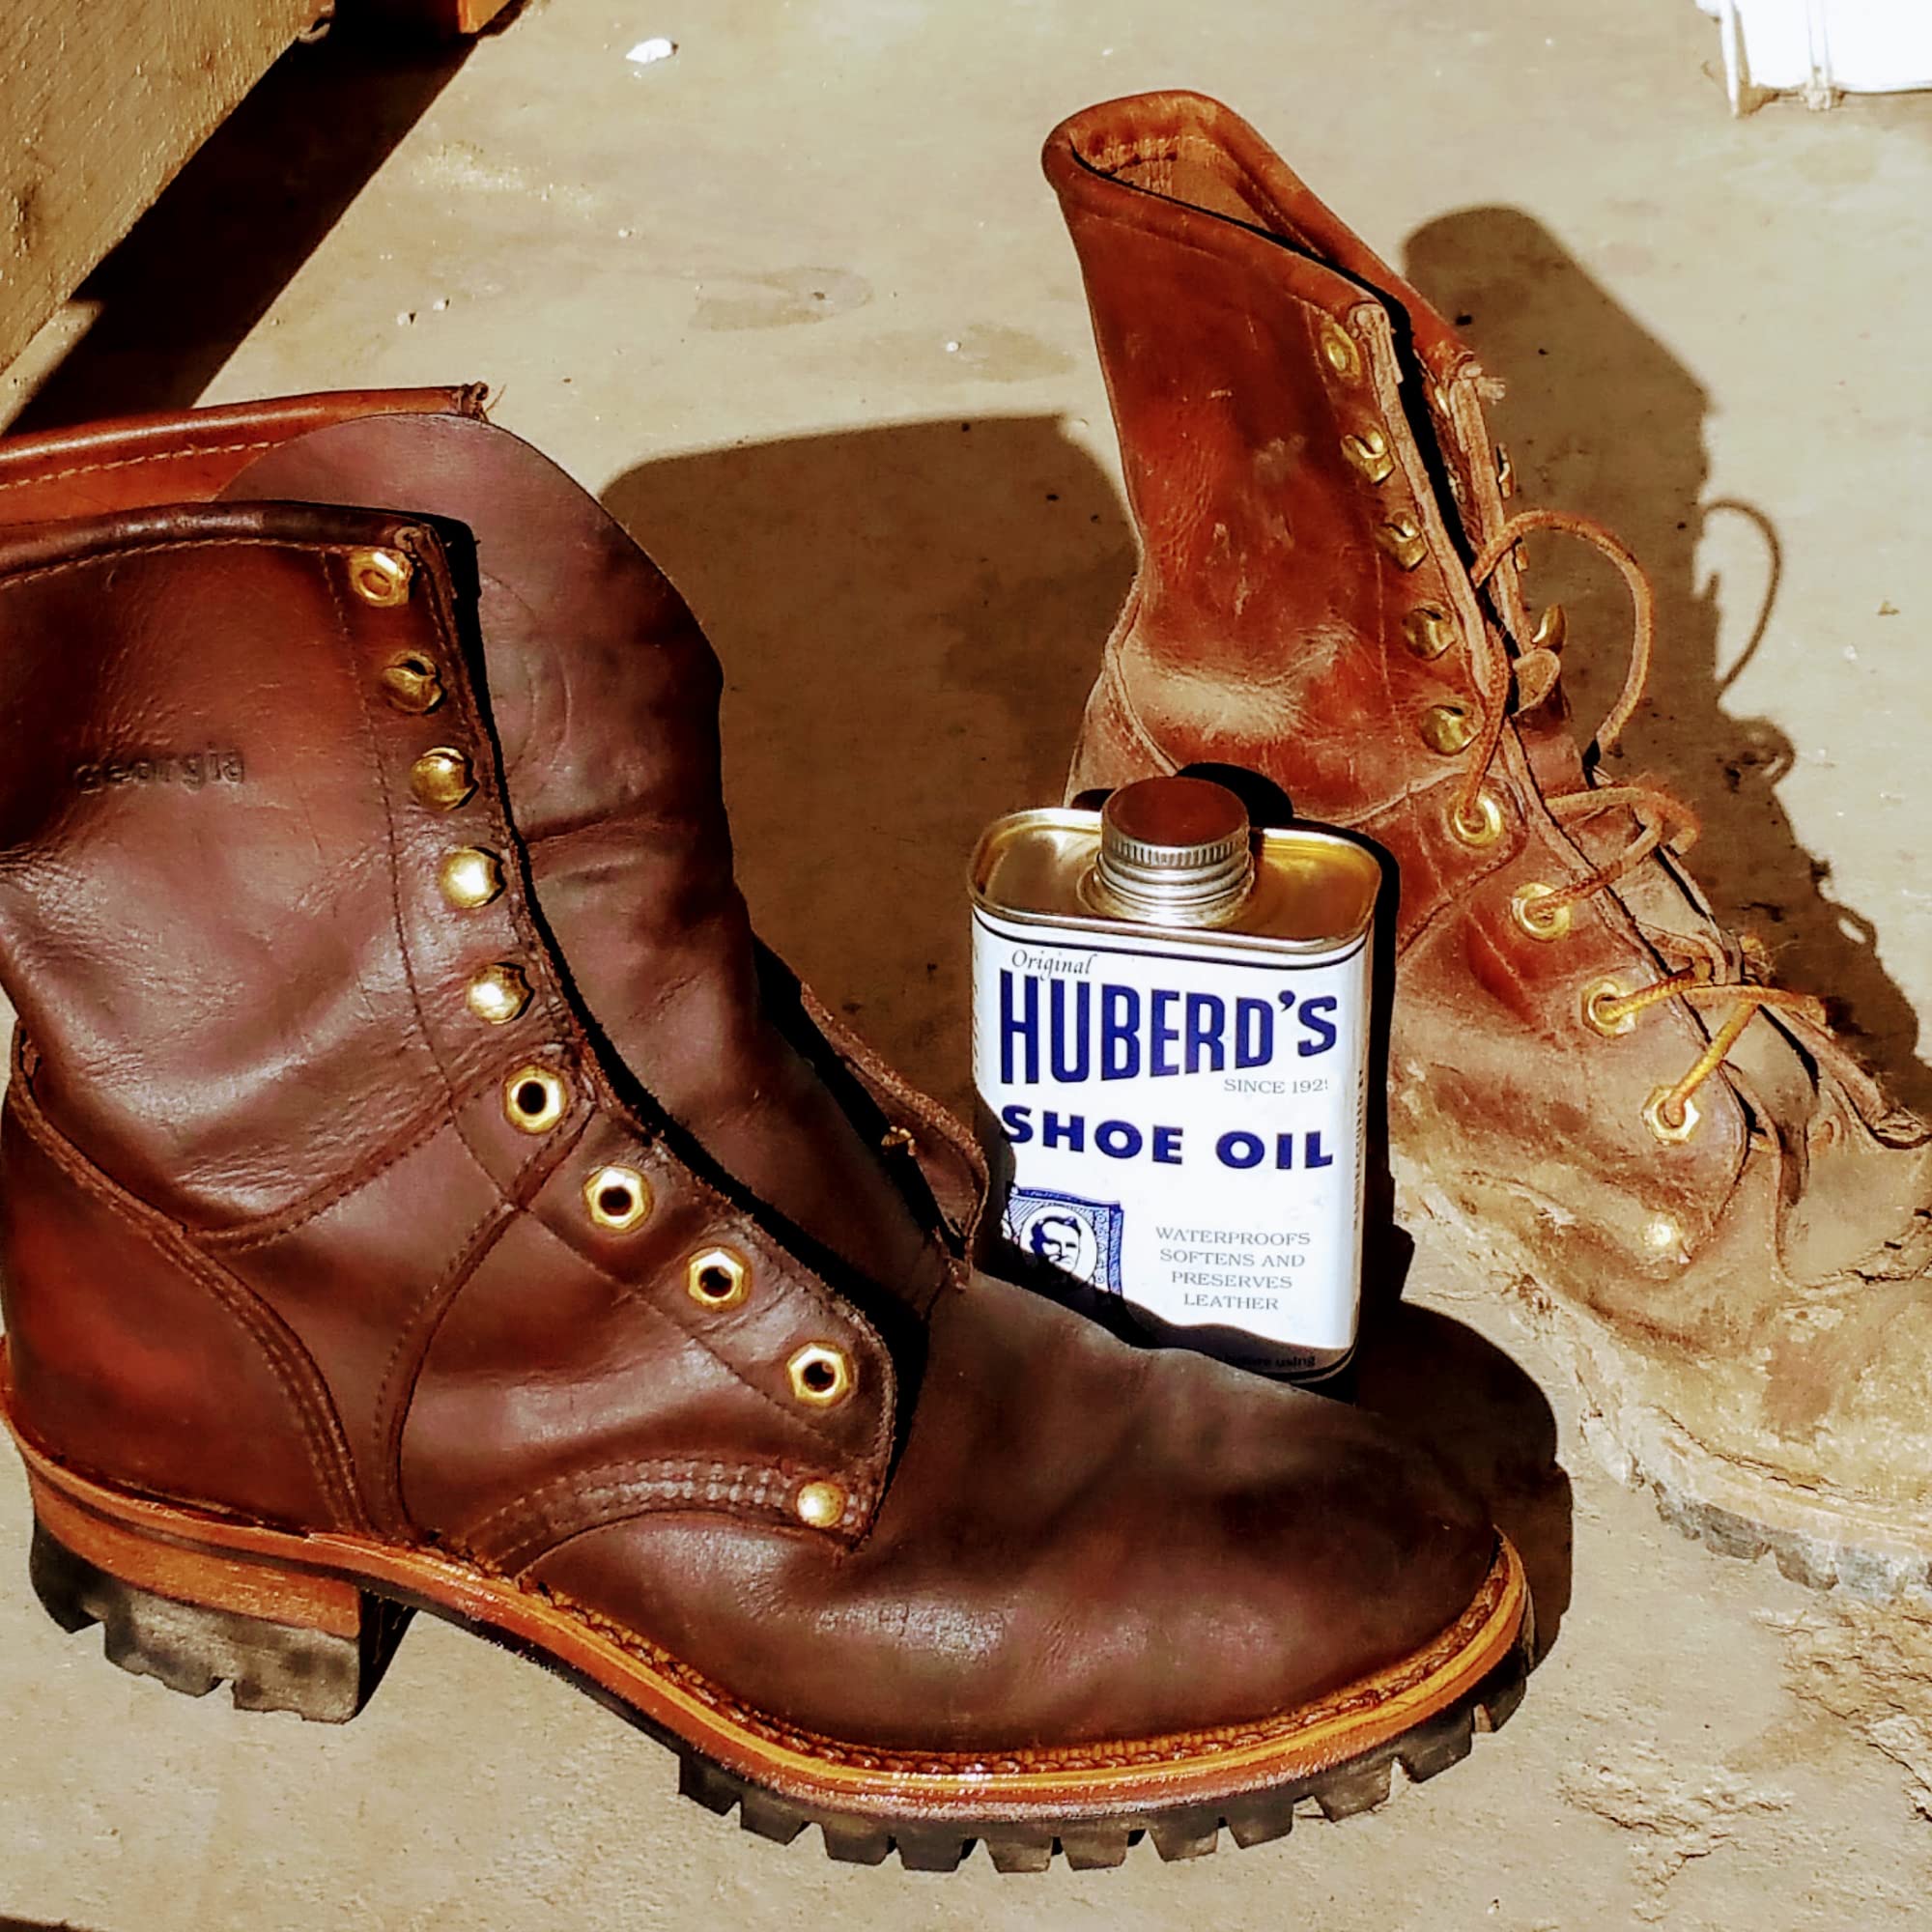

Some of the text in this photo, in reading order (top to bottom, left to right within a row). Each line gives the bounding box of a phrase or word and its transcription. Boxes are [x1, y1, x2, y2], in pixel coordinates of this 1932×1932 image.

[1011, 948, 1097, 981] Original
[999, 969, 1338, 1085] HUBERD'S
[1223, 1078, 1286, 1094] SINCE
[1001, 1104, 1333, 1170] SHOE OIL
[1155, 1226, 1312, 1246] WATERPROOFS
[1159, 1248, 1306, 1268] SOFTENS AND
[1172, 1270, 1293, 1291] PRESERVES
[1183, 1293, 1279, 1312] LEATHER
[1275, 1354, 1317, 1369] using
